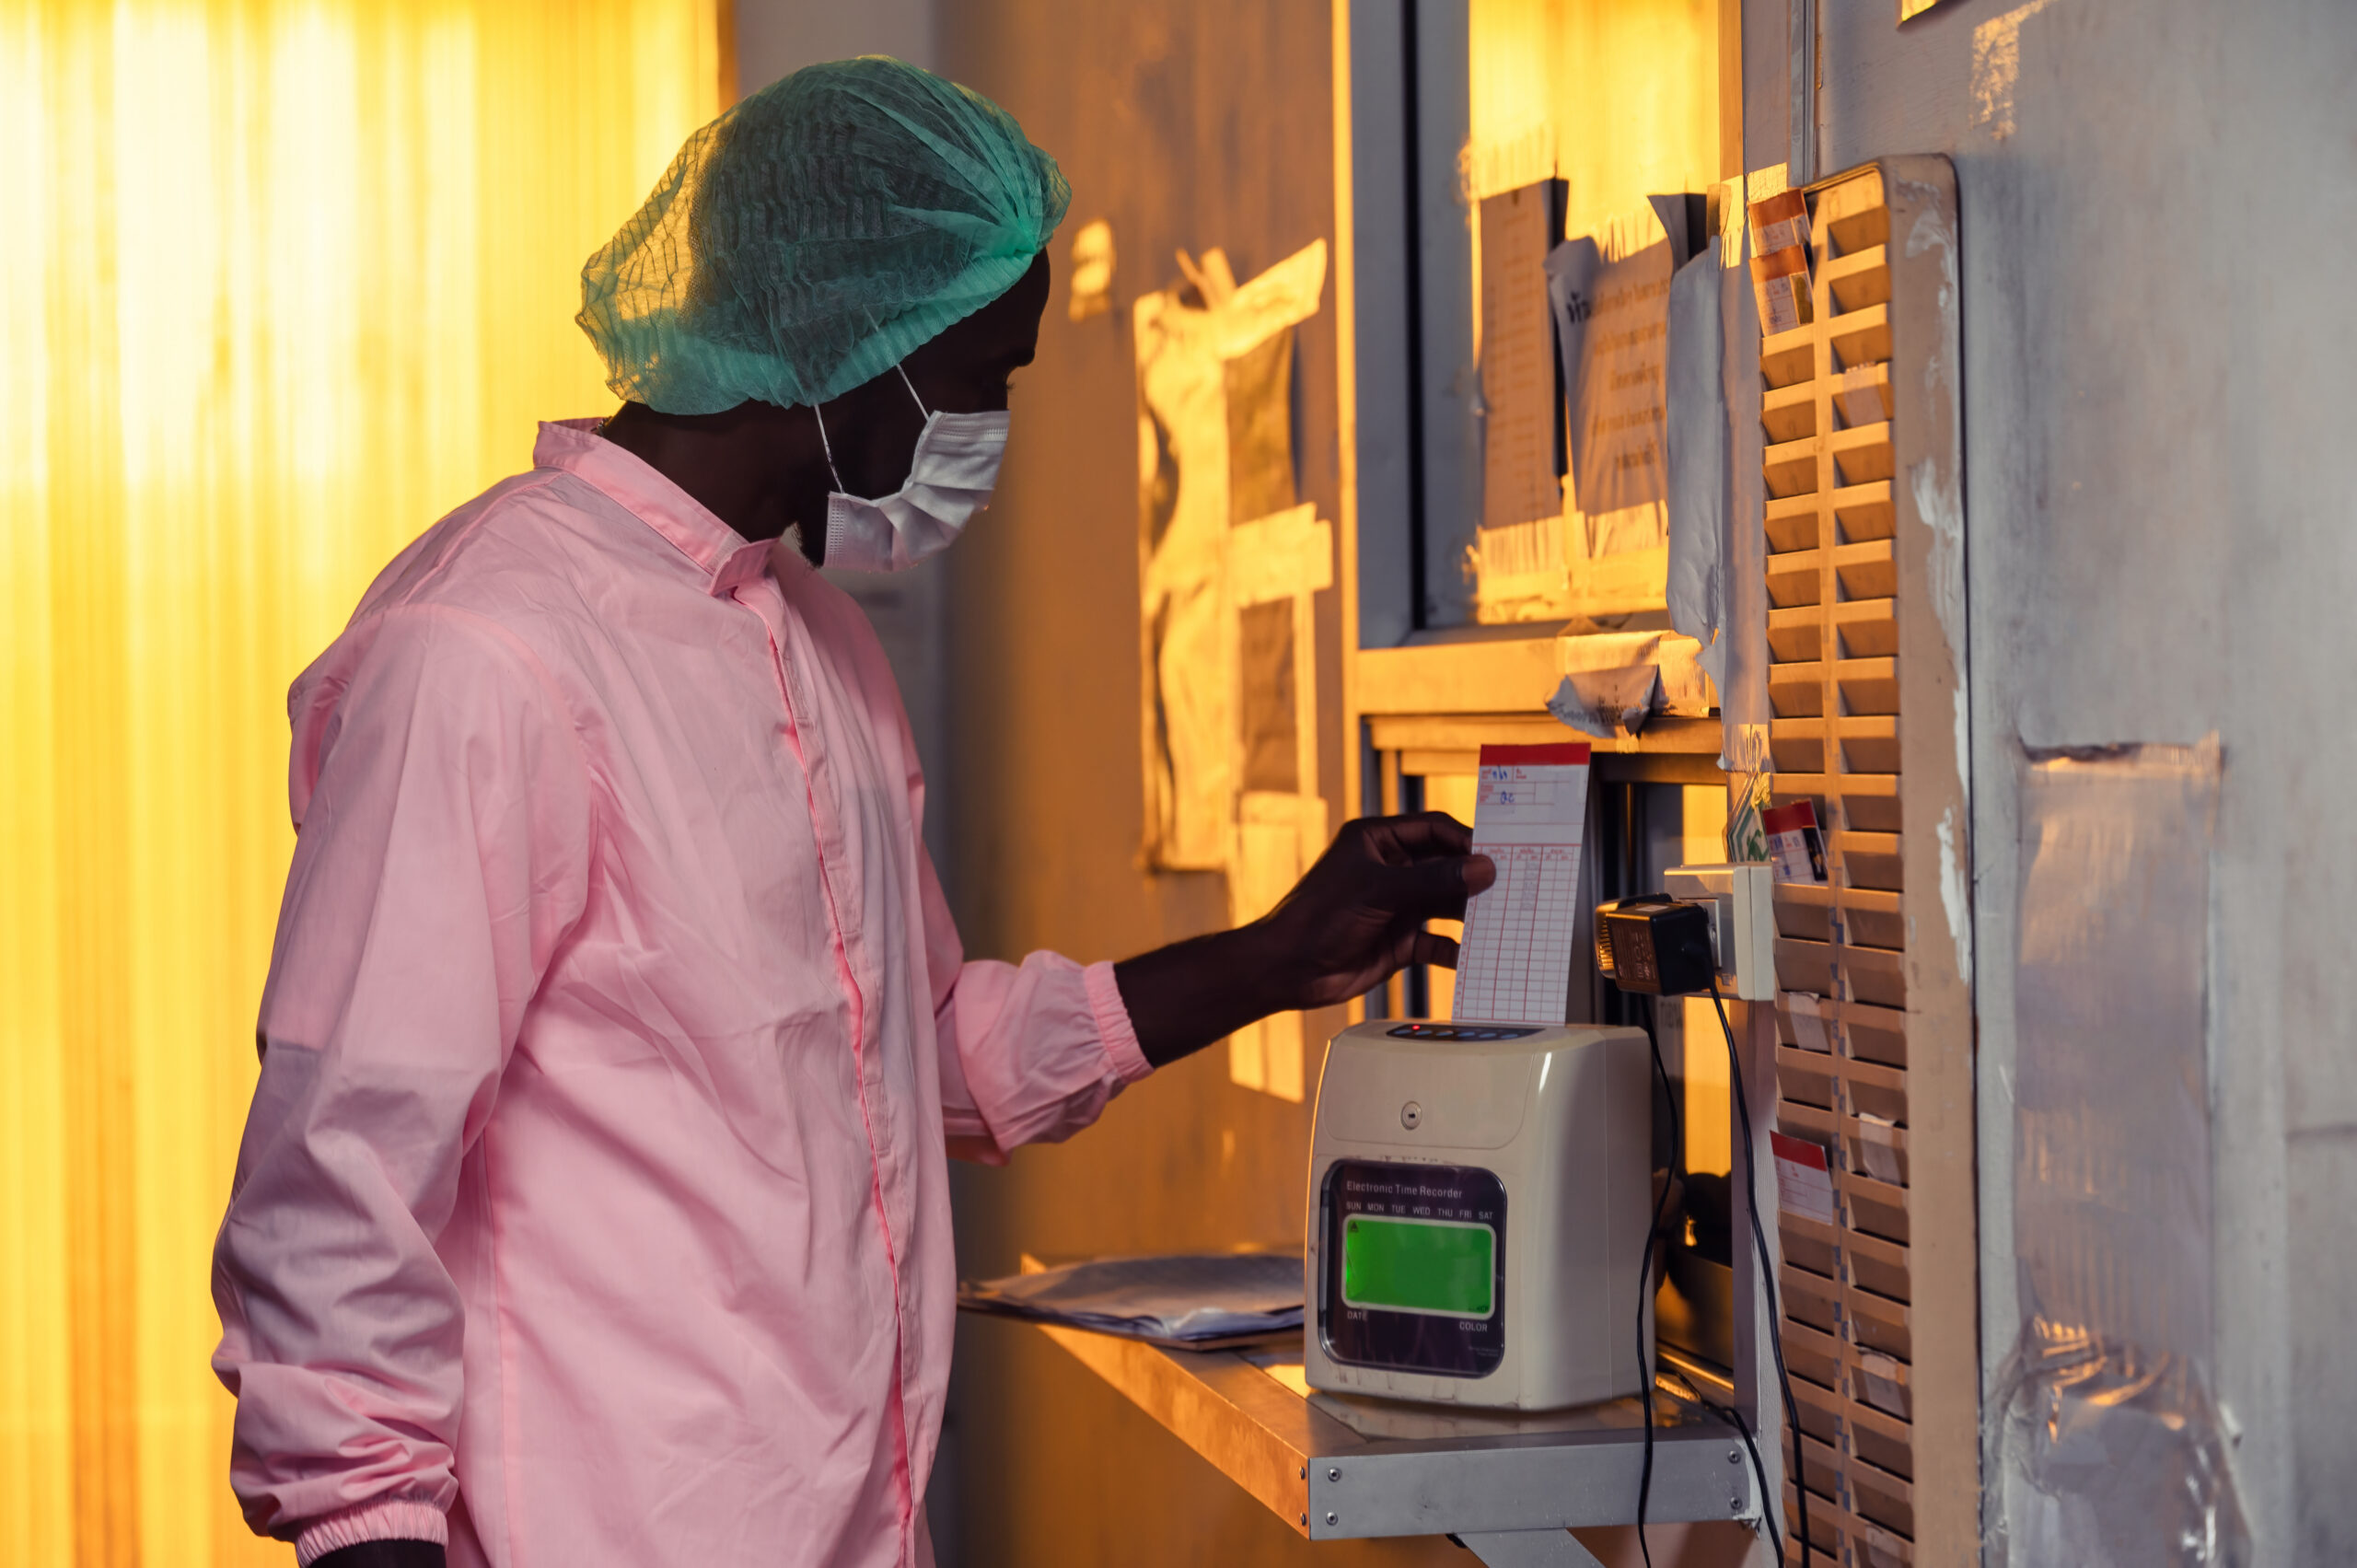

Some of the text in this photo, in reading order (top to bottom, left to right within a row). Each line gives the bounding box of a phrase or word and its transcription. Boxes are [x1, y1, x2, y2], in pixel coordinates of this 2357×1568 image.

[1347, 1180, 1463, 1198] Electronic Time Recorder
[1346, 1202, 1493, 1220] SUN MON TUE WED THU FRI SAT
[1347, 1311, 1367, 1321] DATE
[1459, 1321, 1488, 1332] COLOR
